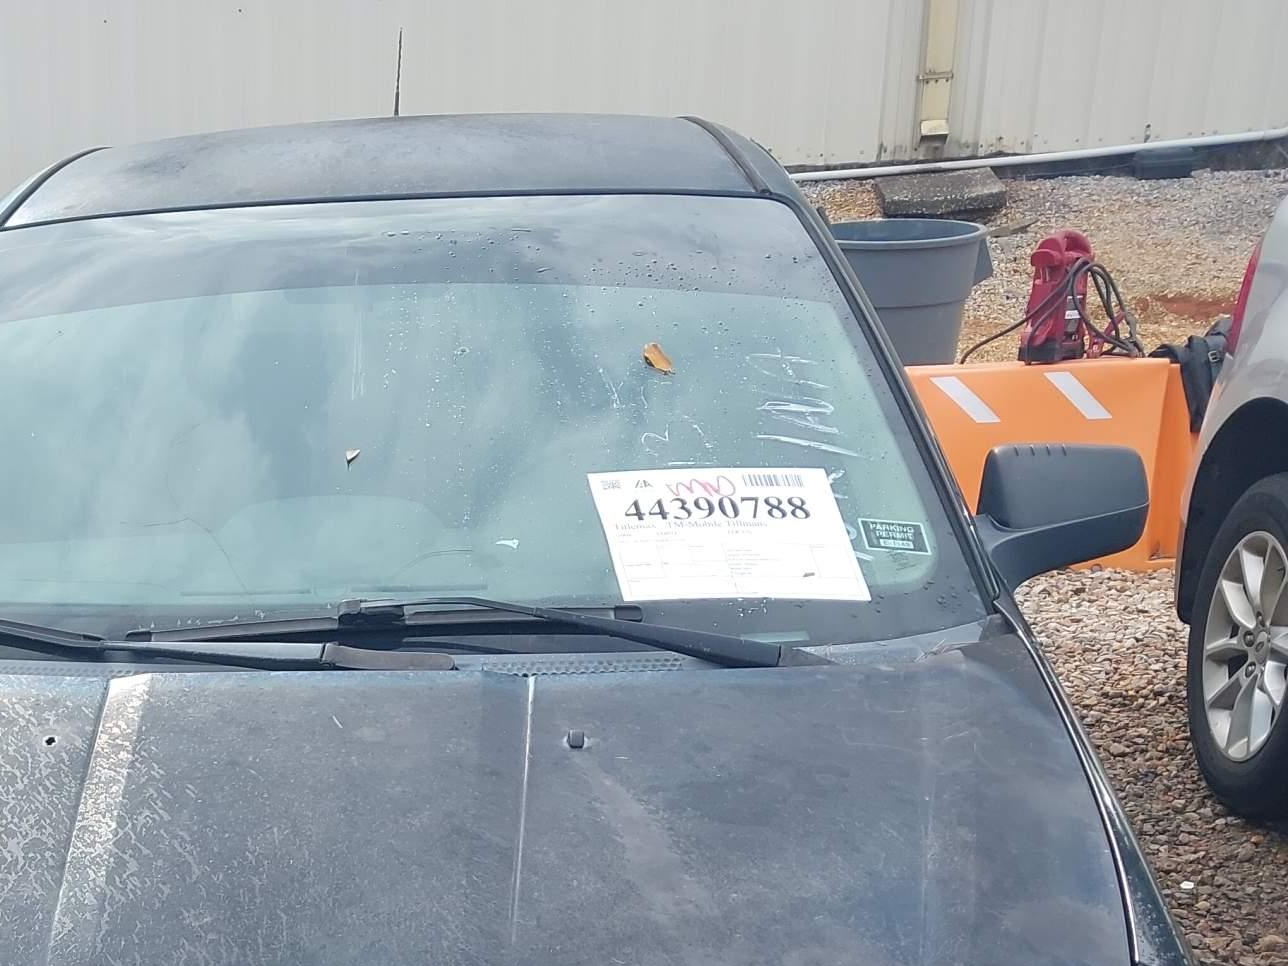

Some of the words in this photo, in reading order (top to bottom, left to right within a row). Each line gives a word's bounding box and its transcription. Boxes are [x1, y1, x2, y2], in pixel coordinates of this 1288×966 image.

[624, 496, 811, 521] 44390788
[869, 522, 915, 533] PARKING
[875, 530, 915, 540] PERMIT
